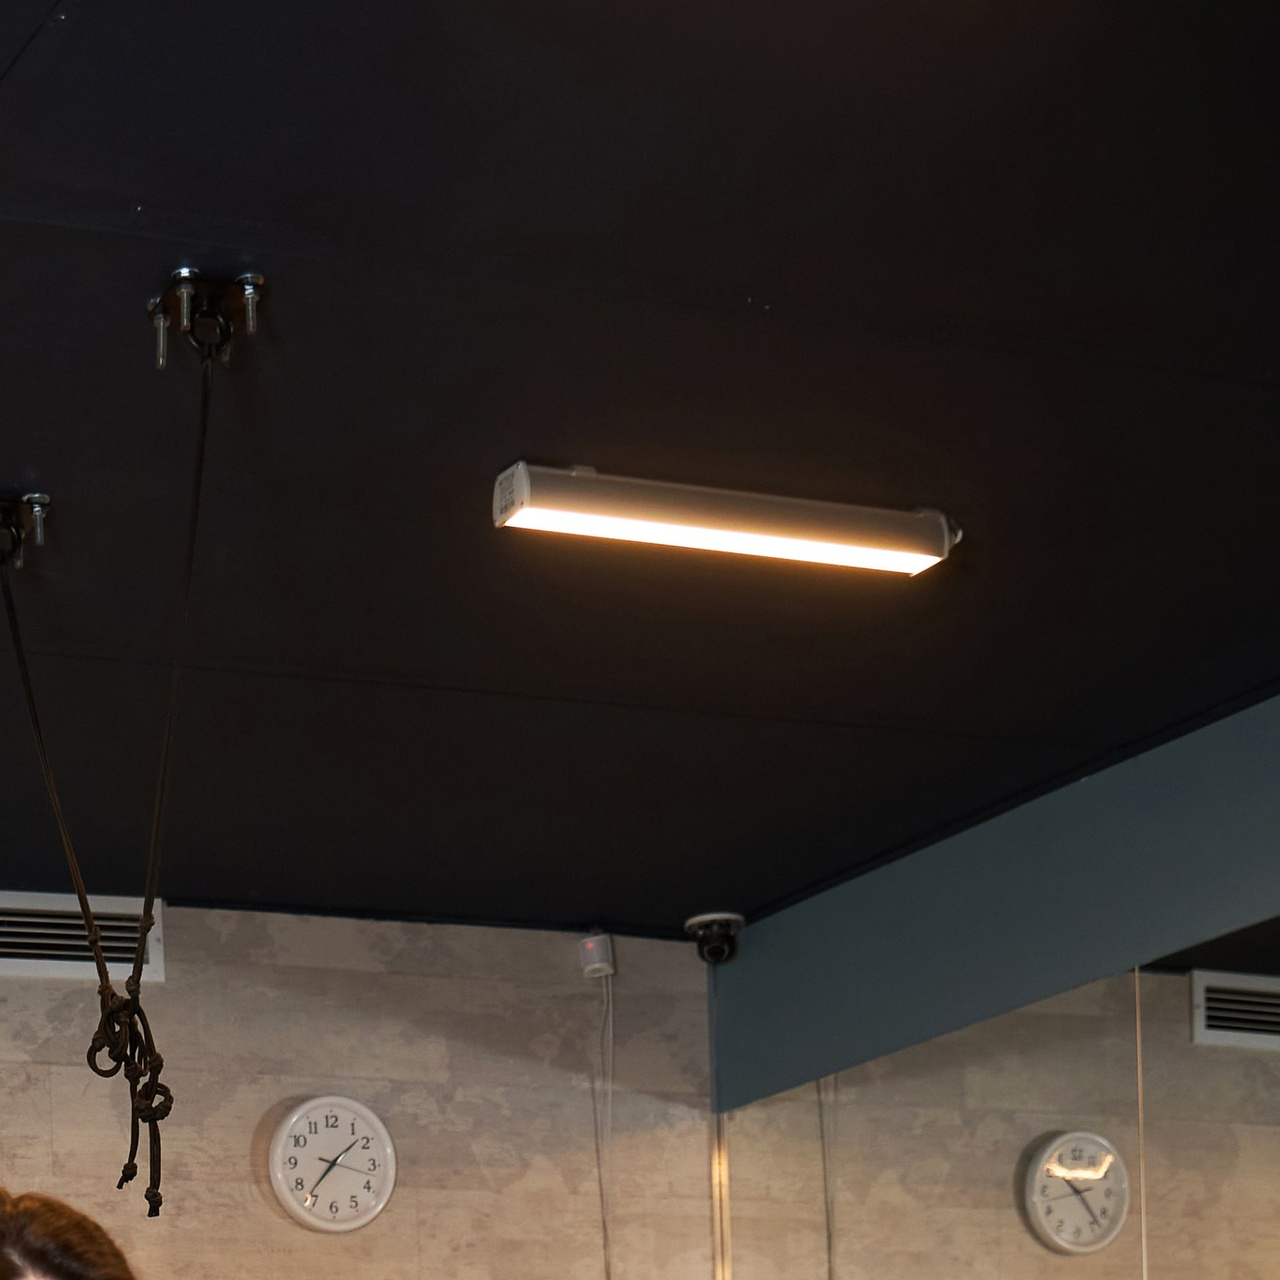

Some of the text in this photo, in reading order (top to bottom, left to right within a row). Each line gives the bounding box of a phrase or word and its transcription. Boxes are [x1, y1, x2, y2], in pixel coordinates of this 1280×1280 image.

[308, 1121, 318, 1135] 11
[325, 1115, 339, 1129] 12
[351, 1122, 356, 1136] 1
[293, 1134, 307, 1149] 10
[361, 1136, 371, 1150] 2
[288, 1156, 298, 1170] 9
[367, 1158, 377, 1172] 3
[294, 1177, 304, 1191] 8
[362, 1180, 372, 1193] 4
[310, 1194, 319, 1208] 7
[329, 1200, 339, 1215] 6
[349, 1195, 359, 1209] 5
